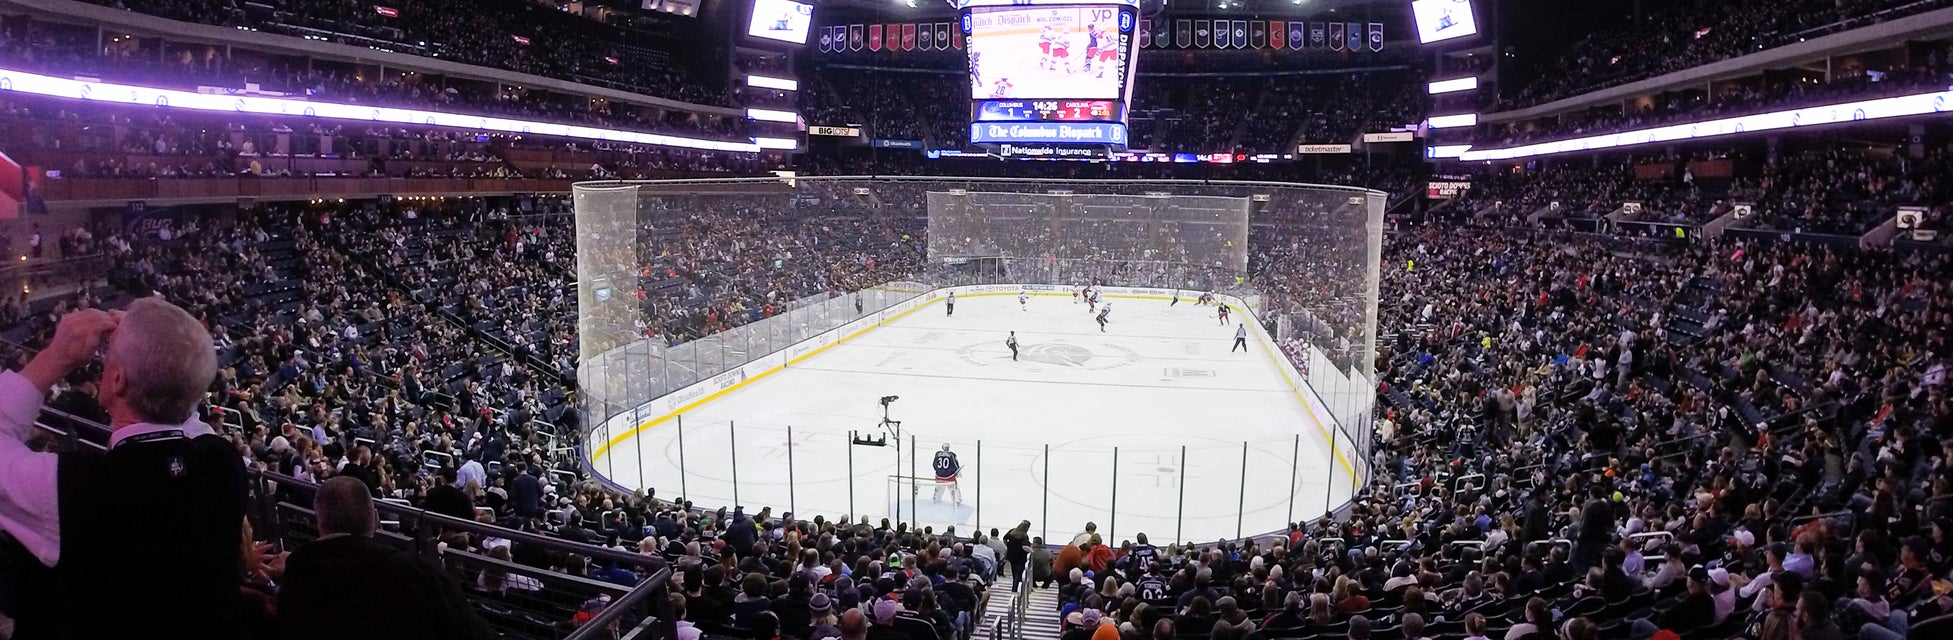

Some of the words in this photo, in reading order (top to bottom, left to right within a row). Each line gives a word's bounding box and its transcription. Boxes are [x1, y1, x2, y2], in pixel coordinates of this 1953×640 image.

[997, 13, 1032, 27] Dispatch
[1091, 9, 1112, 22] yp
[988, 125, 1009, 138] The
[1010, 124, 1058, 138] Columbus
[1059, 125, 1103, 141] Dispatch
[1012, 147, 1054, 155] Nationwide
[1428, 182, 1449, 190] SCIOTO
[937, 457, 950, 469] 30
